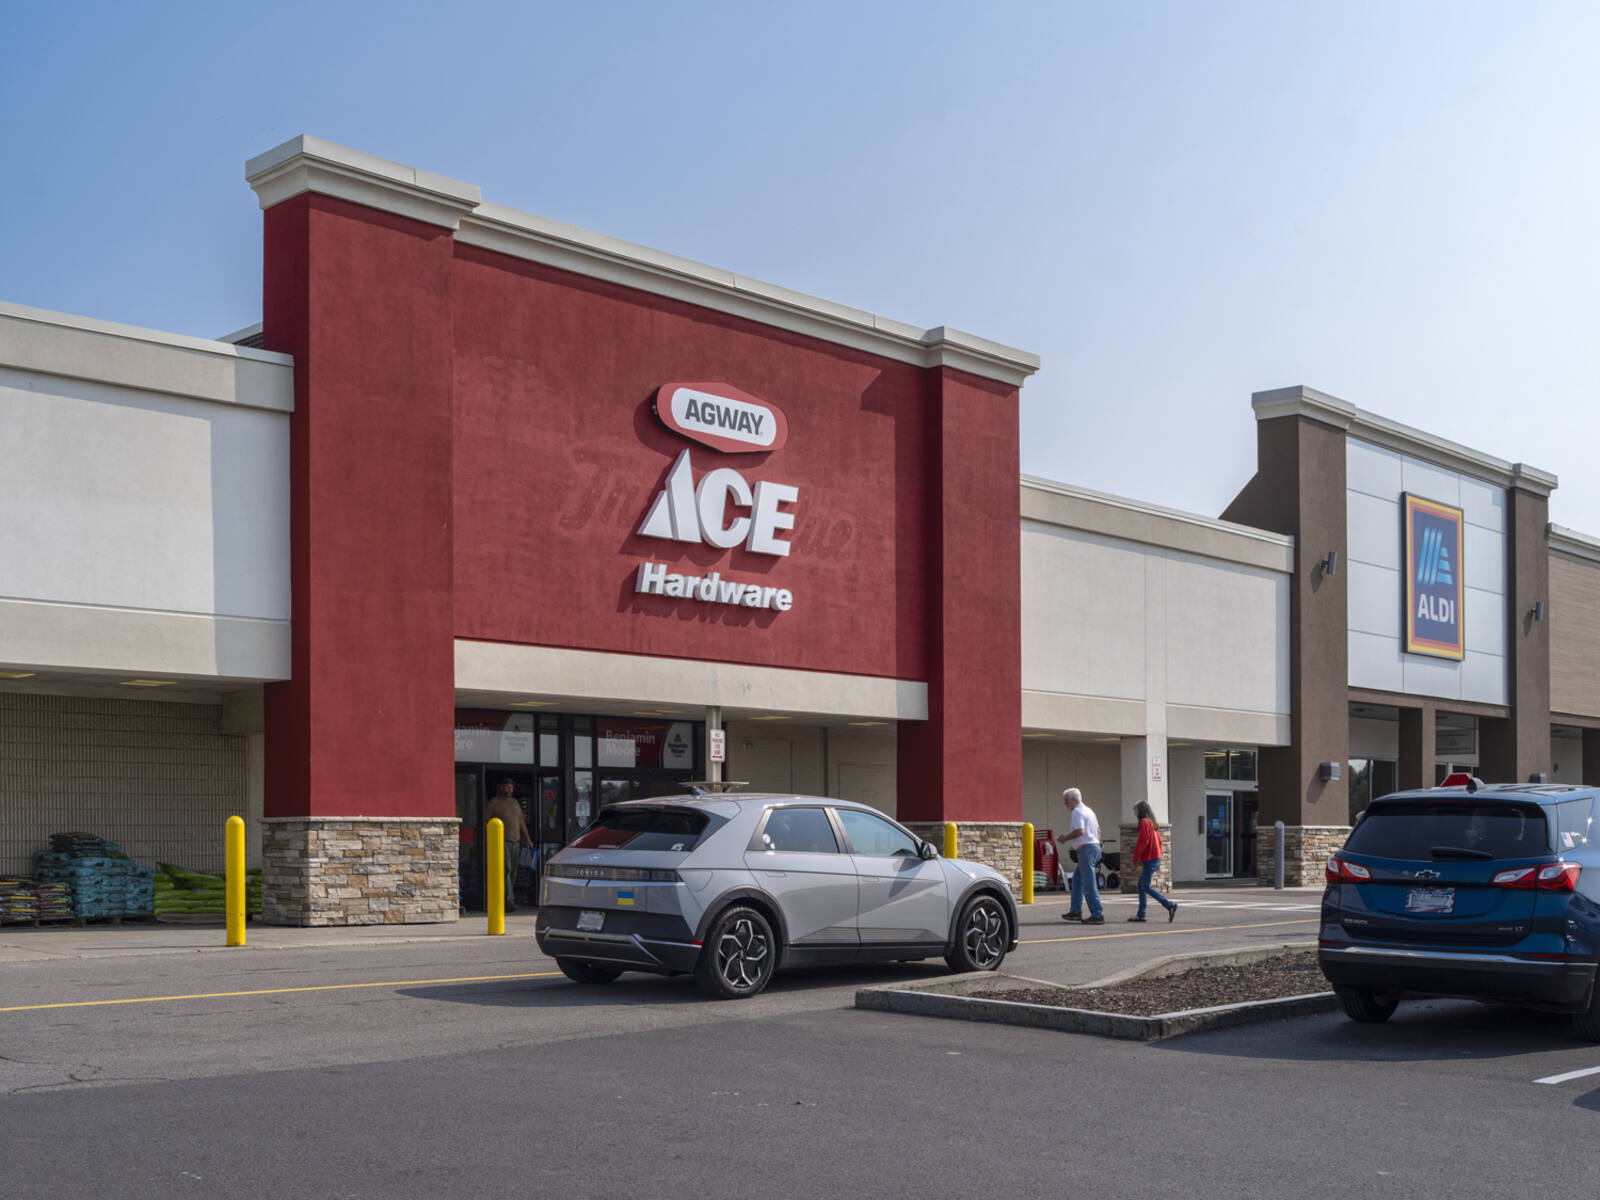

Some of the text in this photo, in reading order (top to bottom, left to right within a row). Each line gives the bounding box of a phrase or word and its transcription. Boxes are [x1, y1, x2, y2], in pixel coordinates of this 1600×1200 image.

[684, 398, 764, 436] AGWAY
[637, 448, 799, 556] ACE
[635, 562, 793, 612] Hardware
[1417, 593, 1455, 625] ALDI
[606, 729, 656, 745] Benjamin
[606, 743, 641, 757] Moore
